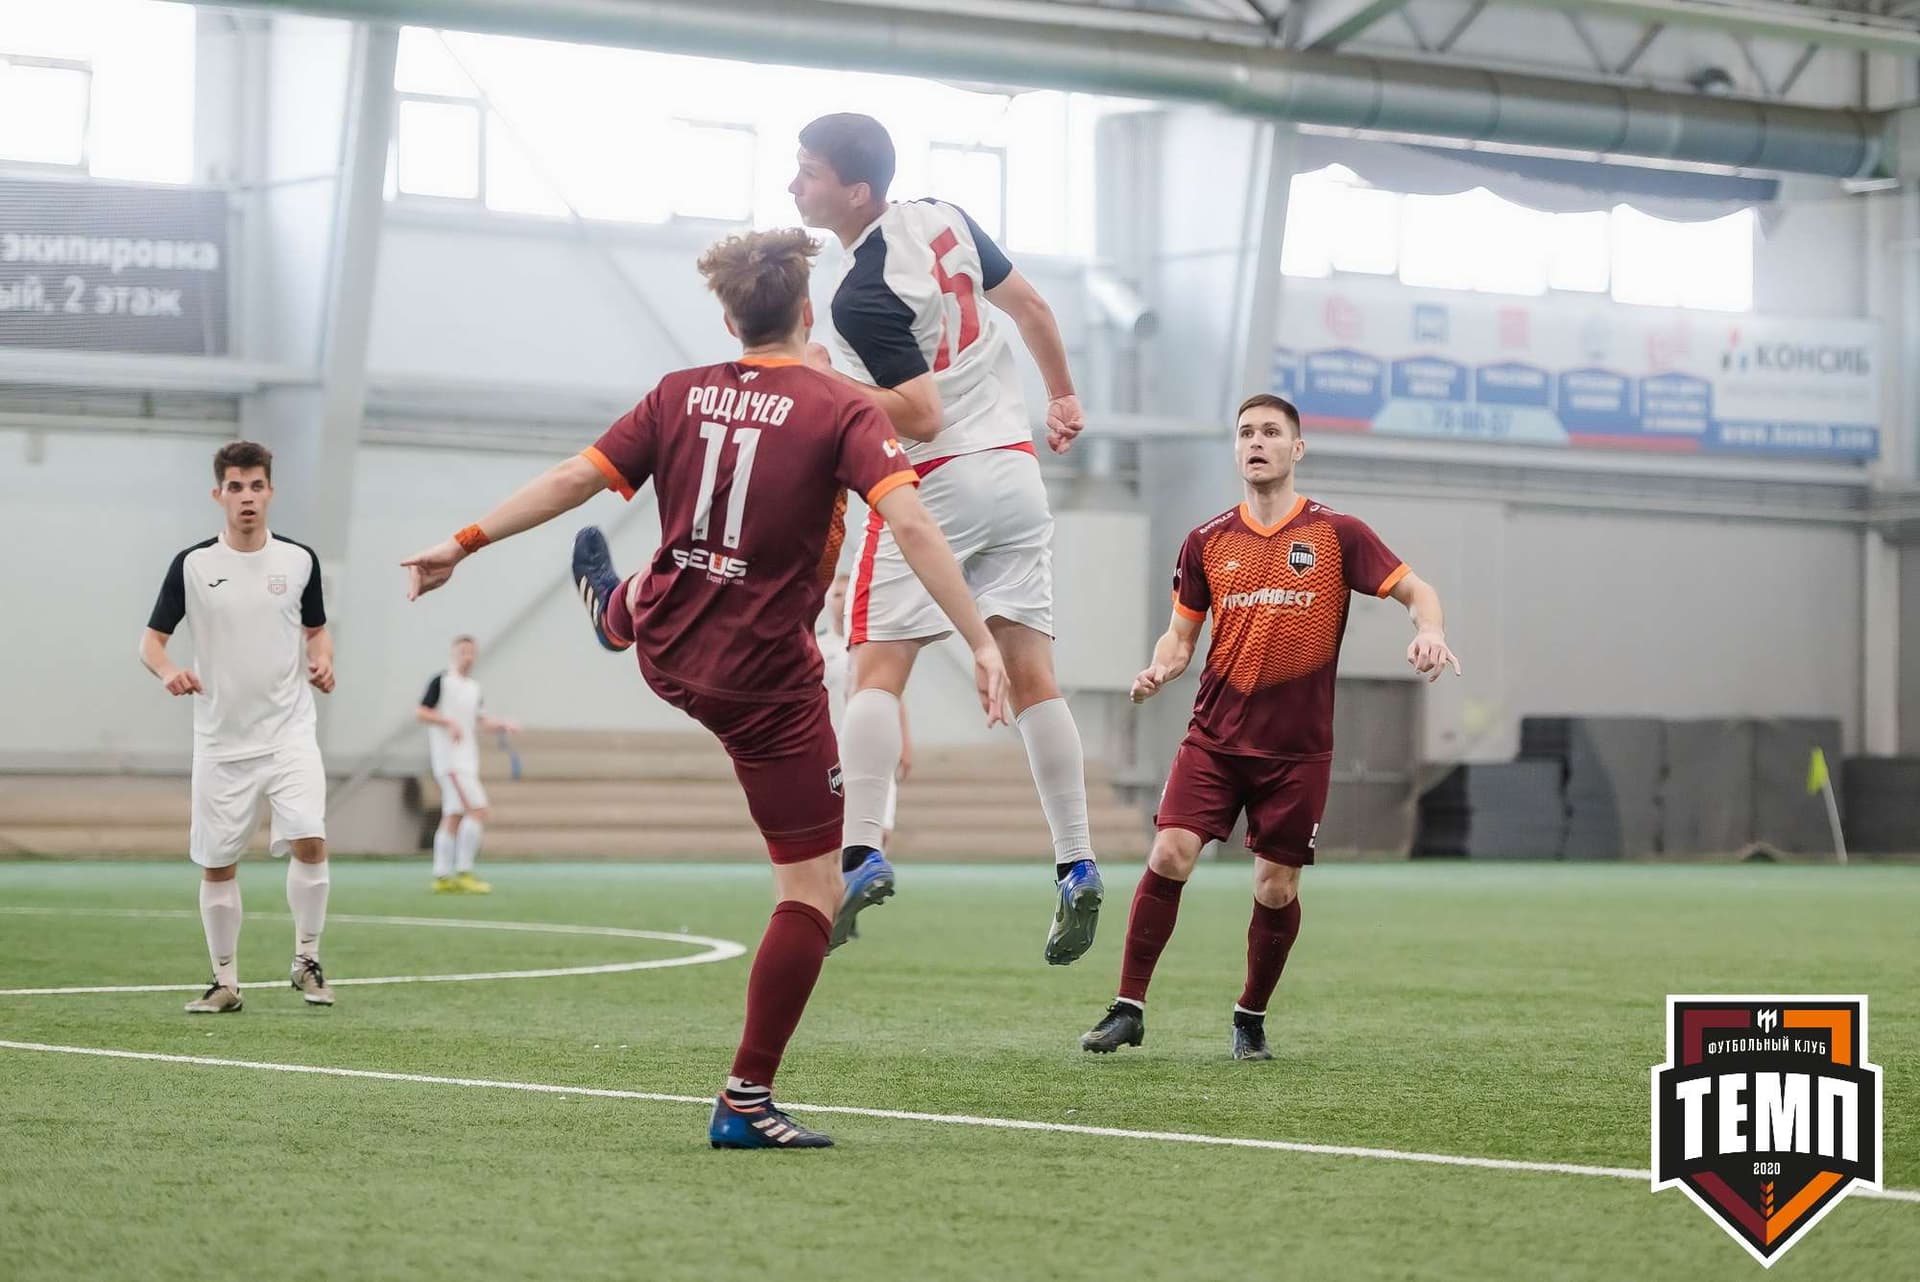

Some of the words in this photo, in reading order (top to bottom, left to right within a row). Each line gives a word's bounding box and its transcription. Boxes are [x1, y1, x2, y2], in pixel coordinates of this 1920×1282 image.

[1, 233, 219, 275] экипировка
[63, 274, 86, 314] 2
[1756, 343, 1872, 377] КОНСИБ
[687, 385, 794, 427] РОДИЧЕВ
[691, 421, 762, 550] 11
[671, 548, 749, 578] SEUS
